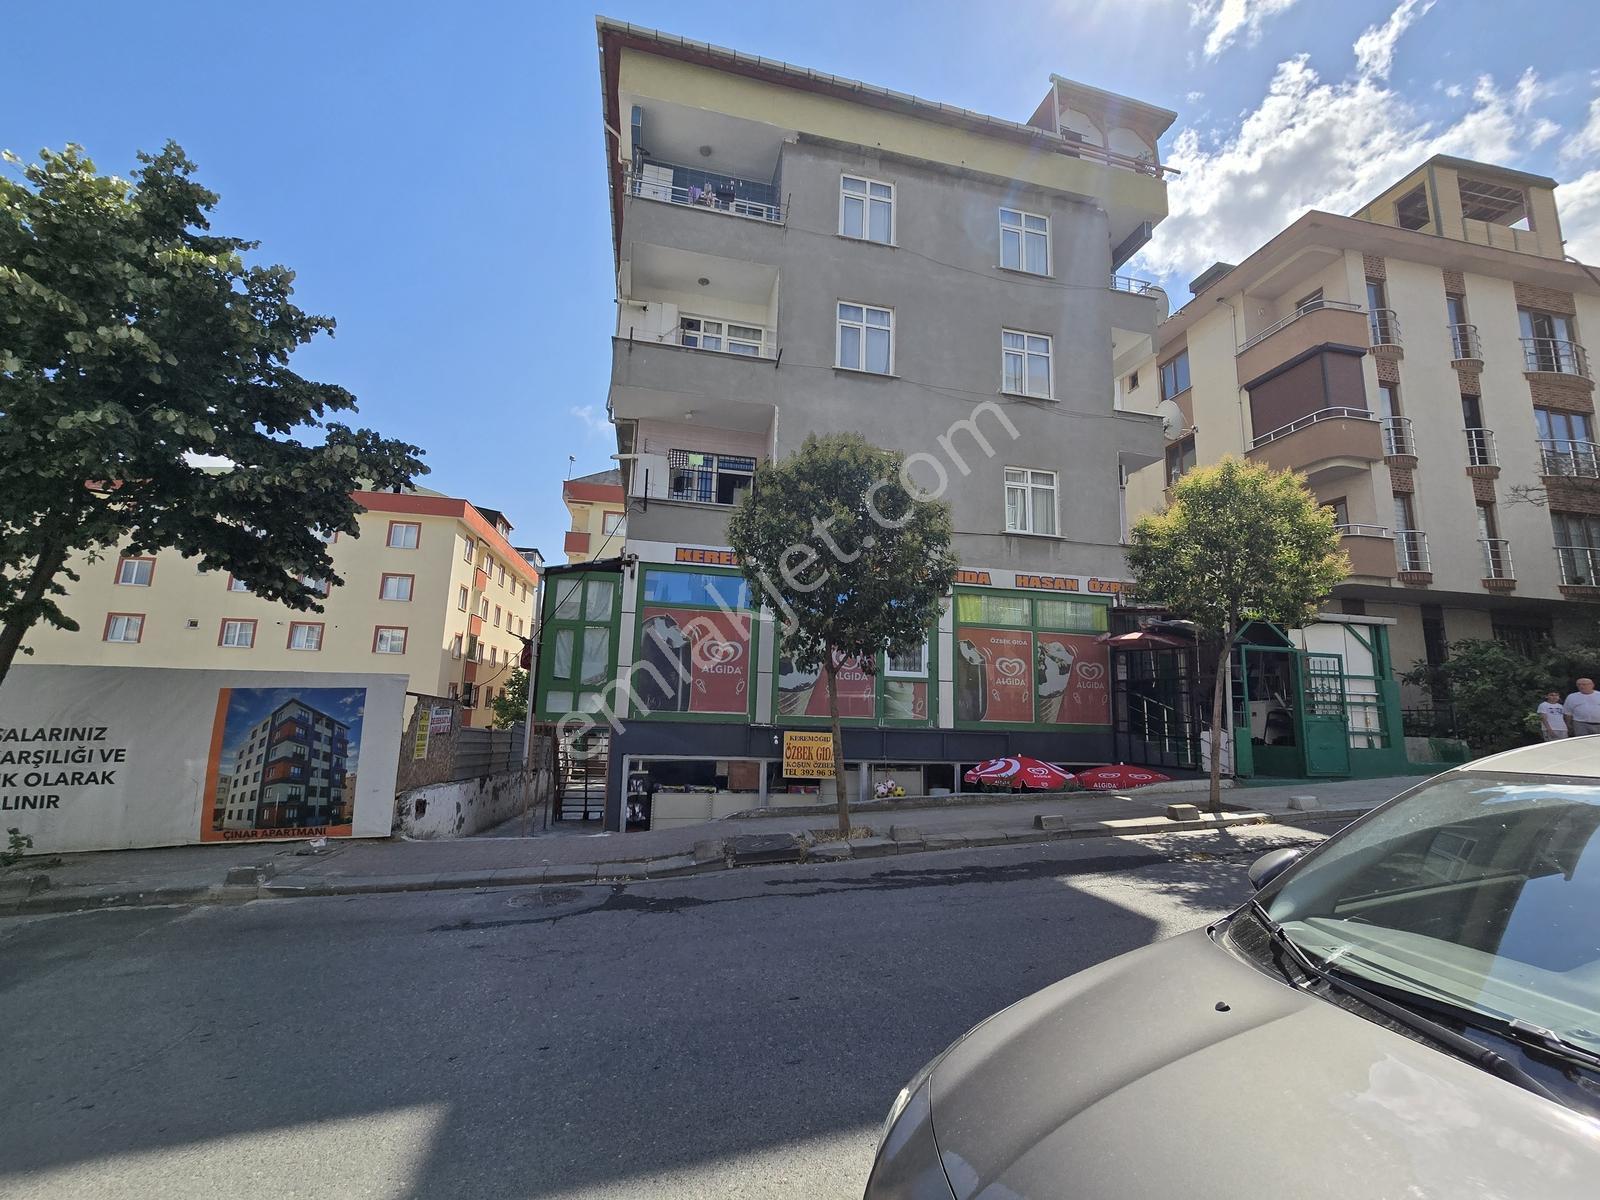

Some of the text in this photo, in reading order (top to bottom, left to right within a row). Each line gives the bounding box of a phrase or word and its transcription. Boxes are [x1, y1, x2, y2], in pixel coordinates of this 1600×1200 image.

[1015, 574, 1079, 591] HASAN
[0, 746, 127, 769] ARŞILIĞI VE
[785, 742, 833, 761] ÖZBEK GID
[0, 771, 117, 788] K OLARAK
[816, 769, 826, 777] 96
[0, 795, 60, 811] LINIR
[223, 828, 327, 841] ÇINAR APARTMANI
